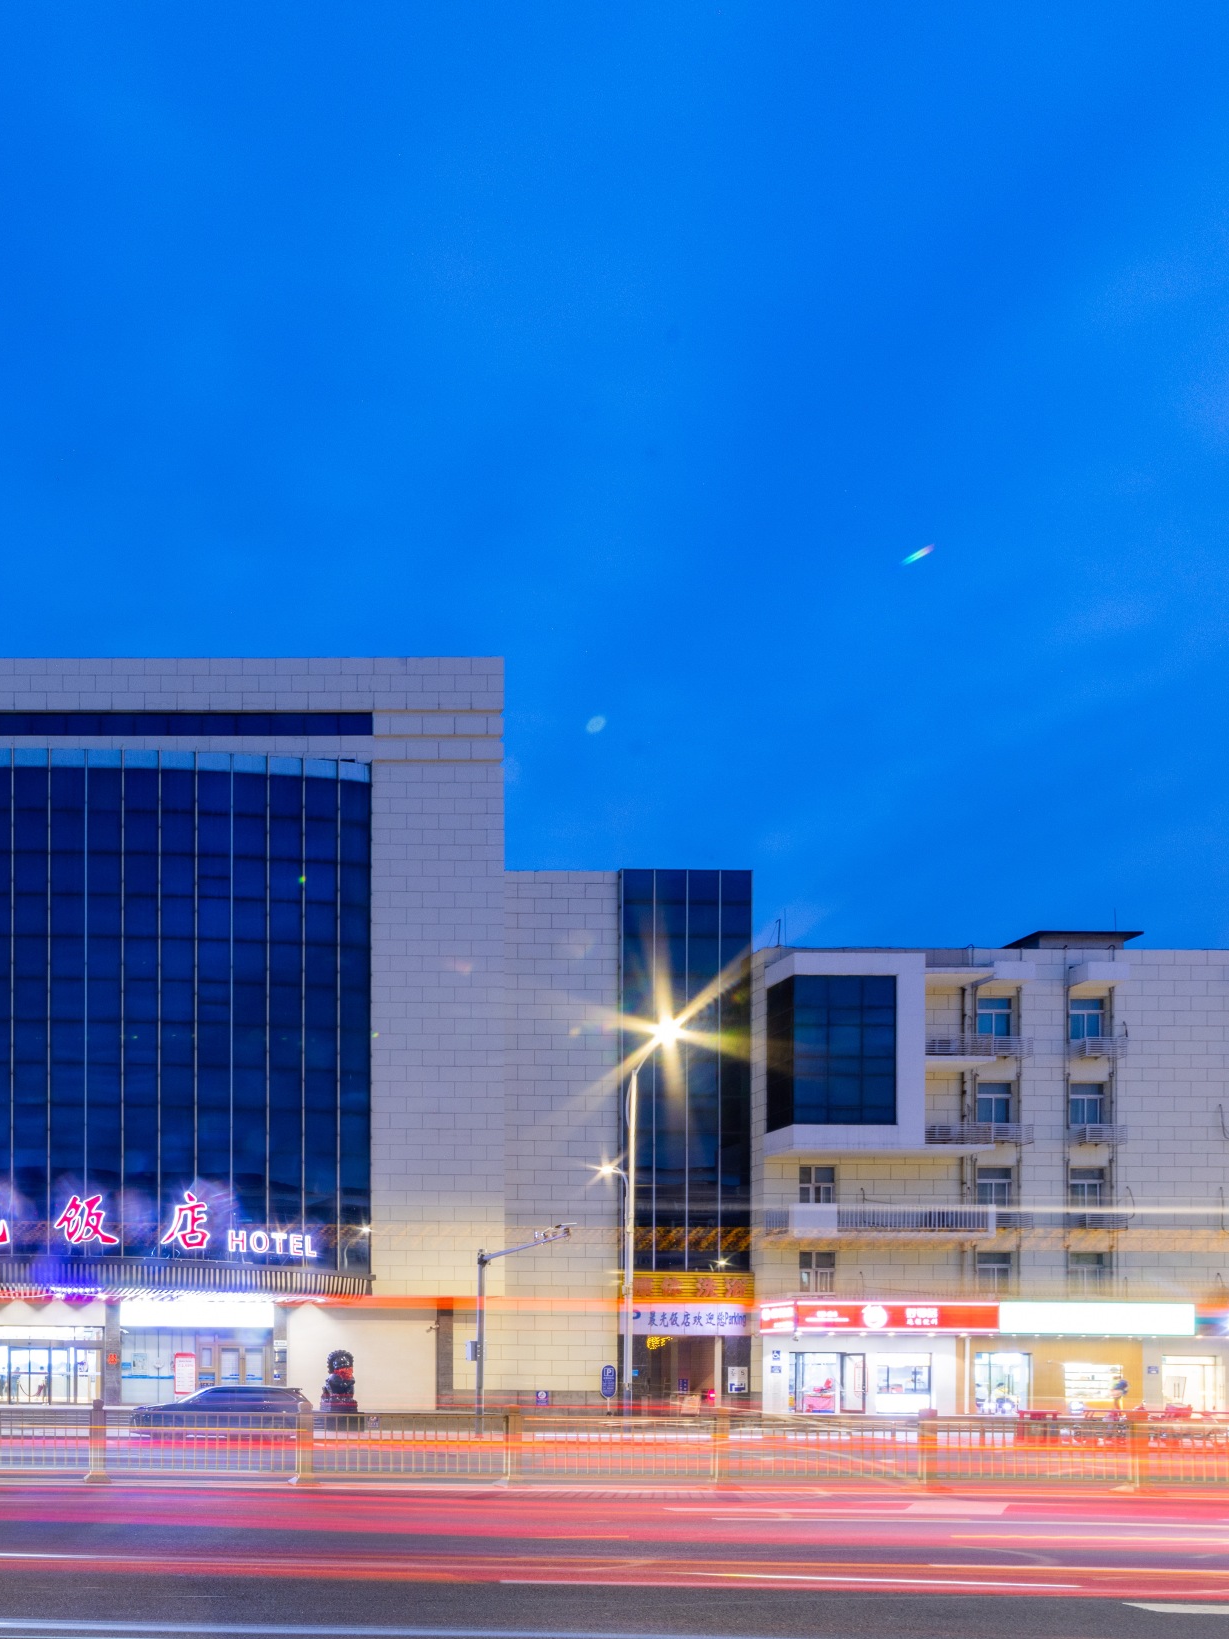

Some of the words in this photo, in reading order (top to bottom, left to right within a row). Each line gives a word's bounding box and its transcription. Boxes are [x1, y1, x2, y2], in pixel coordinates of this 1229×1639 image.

[228, 1230, 317, 1257] HOTEL
[648, 1311, 725, 1327] 晨光饭店欢迎您
[725, 1312, 746, 1327] Parking
